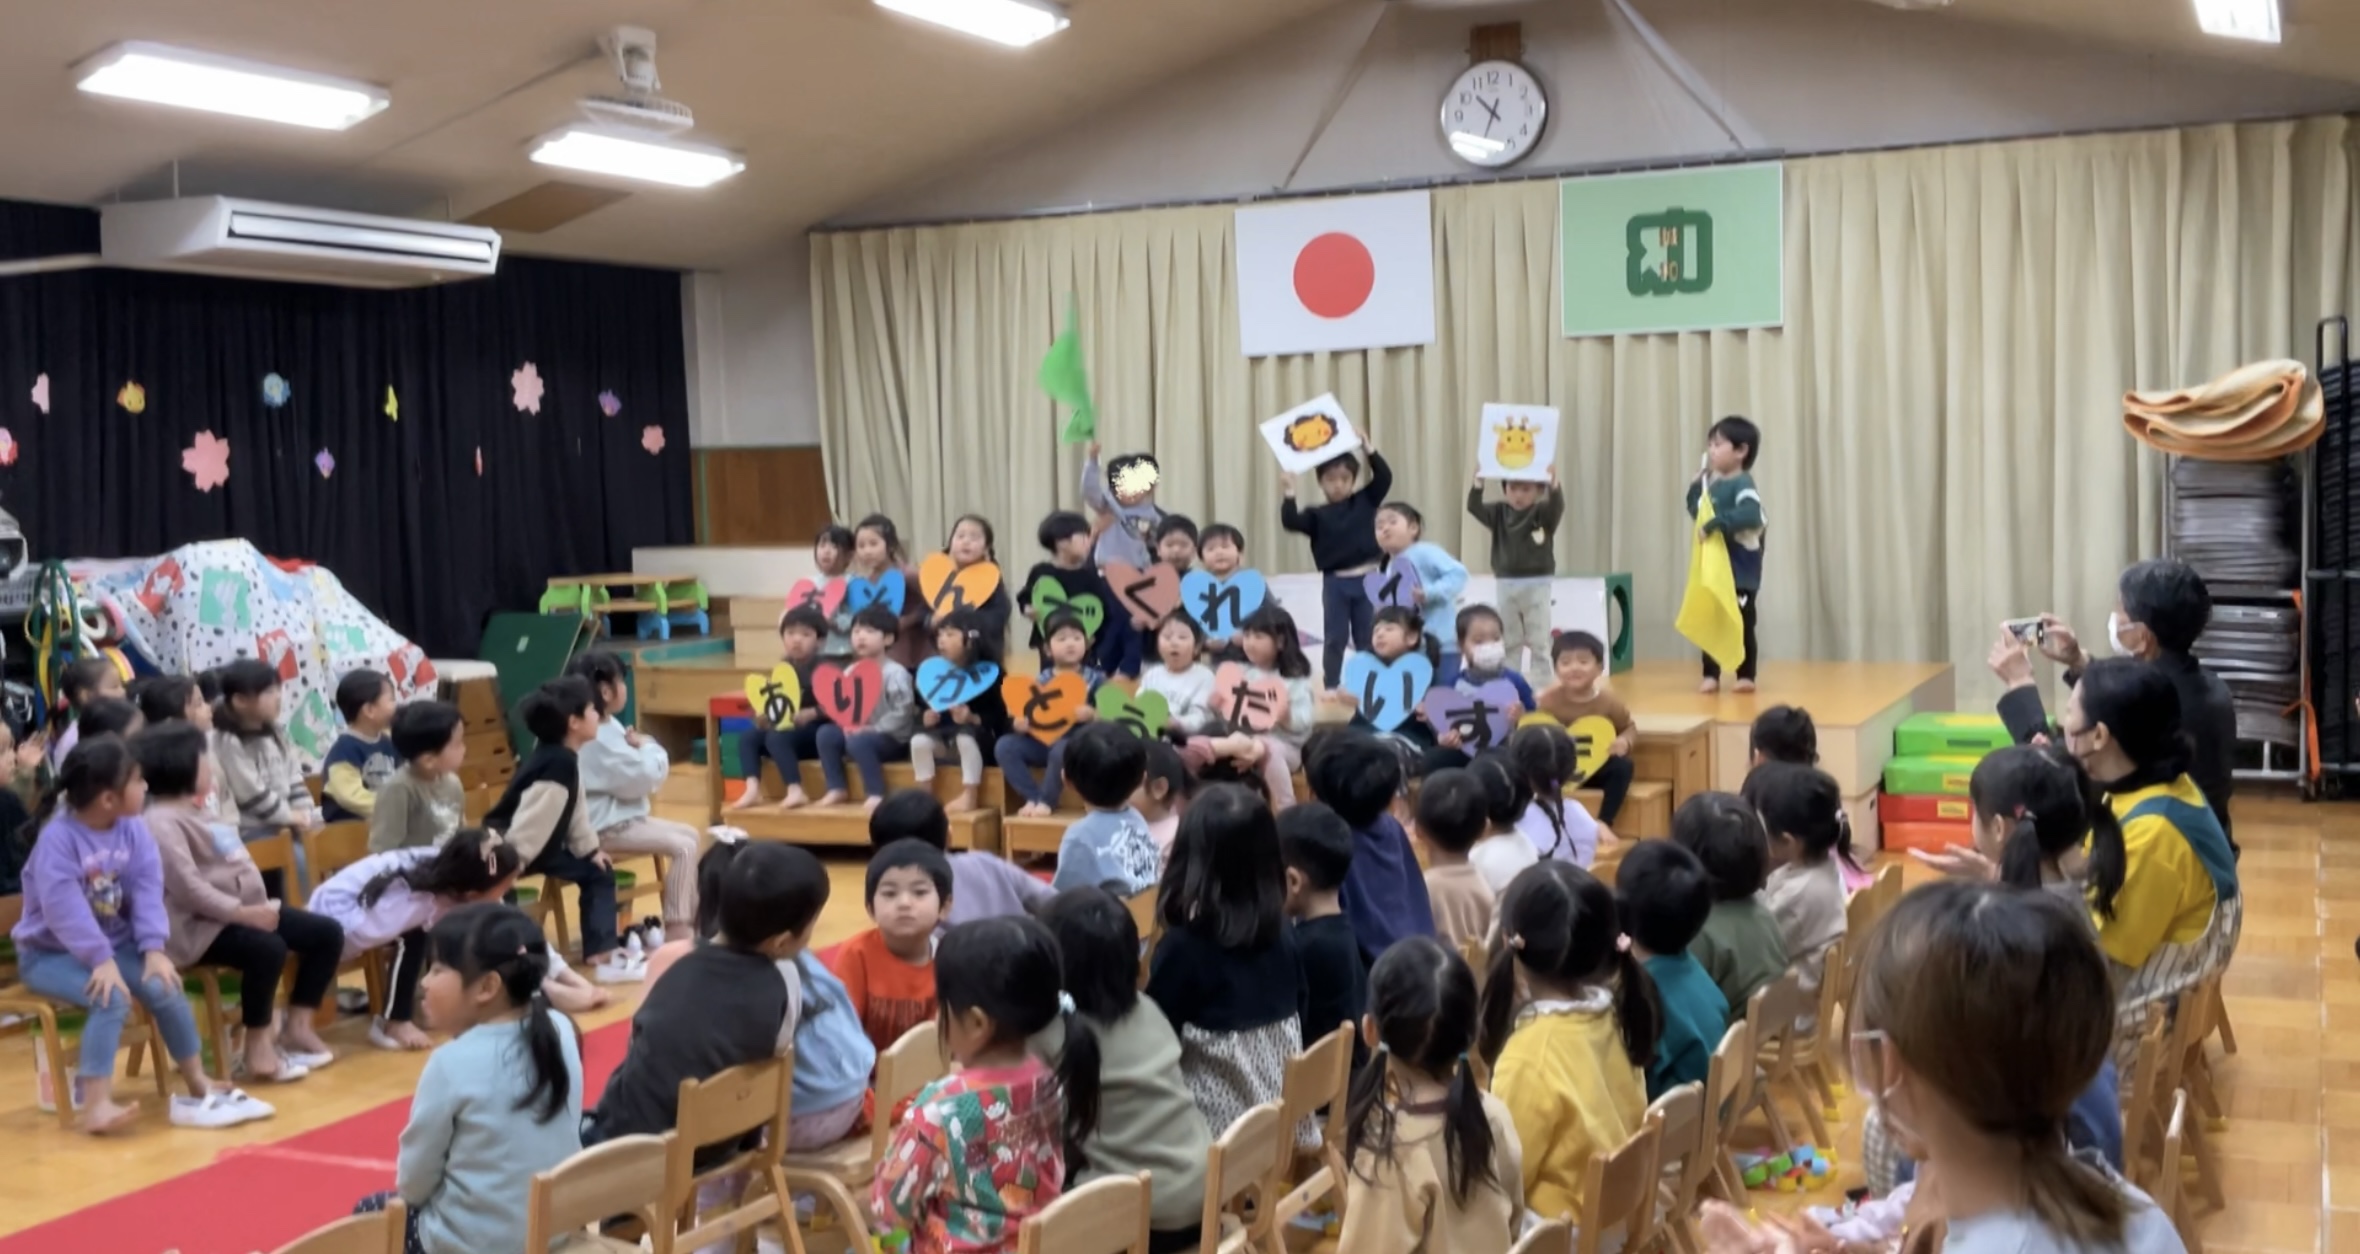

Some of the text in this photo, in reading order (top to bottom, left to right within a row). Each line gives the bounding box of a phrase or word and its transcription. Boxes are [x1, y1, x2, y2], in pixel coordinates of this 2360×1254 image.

[1460, 91, 1472, 106] 10
[1472, 77, 1482, 91] 11
[1487, 71, 1499, 85] 12
[1125, 576, 1160, 619] く
[1199, 583, 1240, 632] れ
[760, 681, 796, 723] あ
[836, 676, 862, 722] り
[927, 665, 992, 702] が
[1365, 670, 1414, 720] い
[1023, 685, 1068, 730] と
[1230, 680, 1278, 732] だ
[1445, 700, 1499, 748] す
